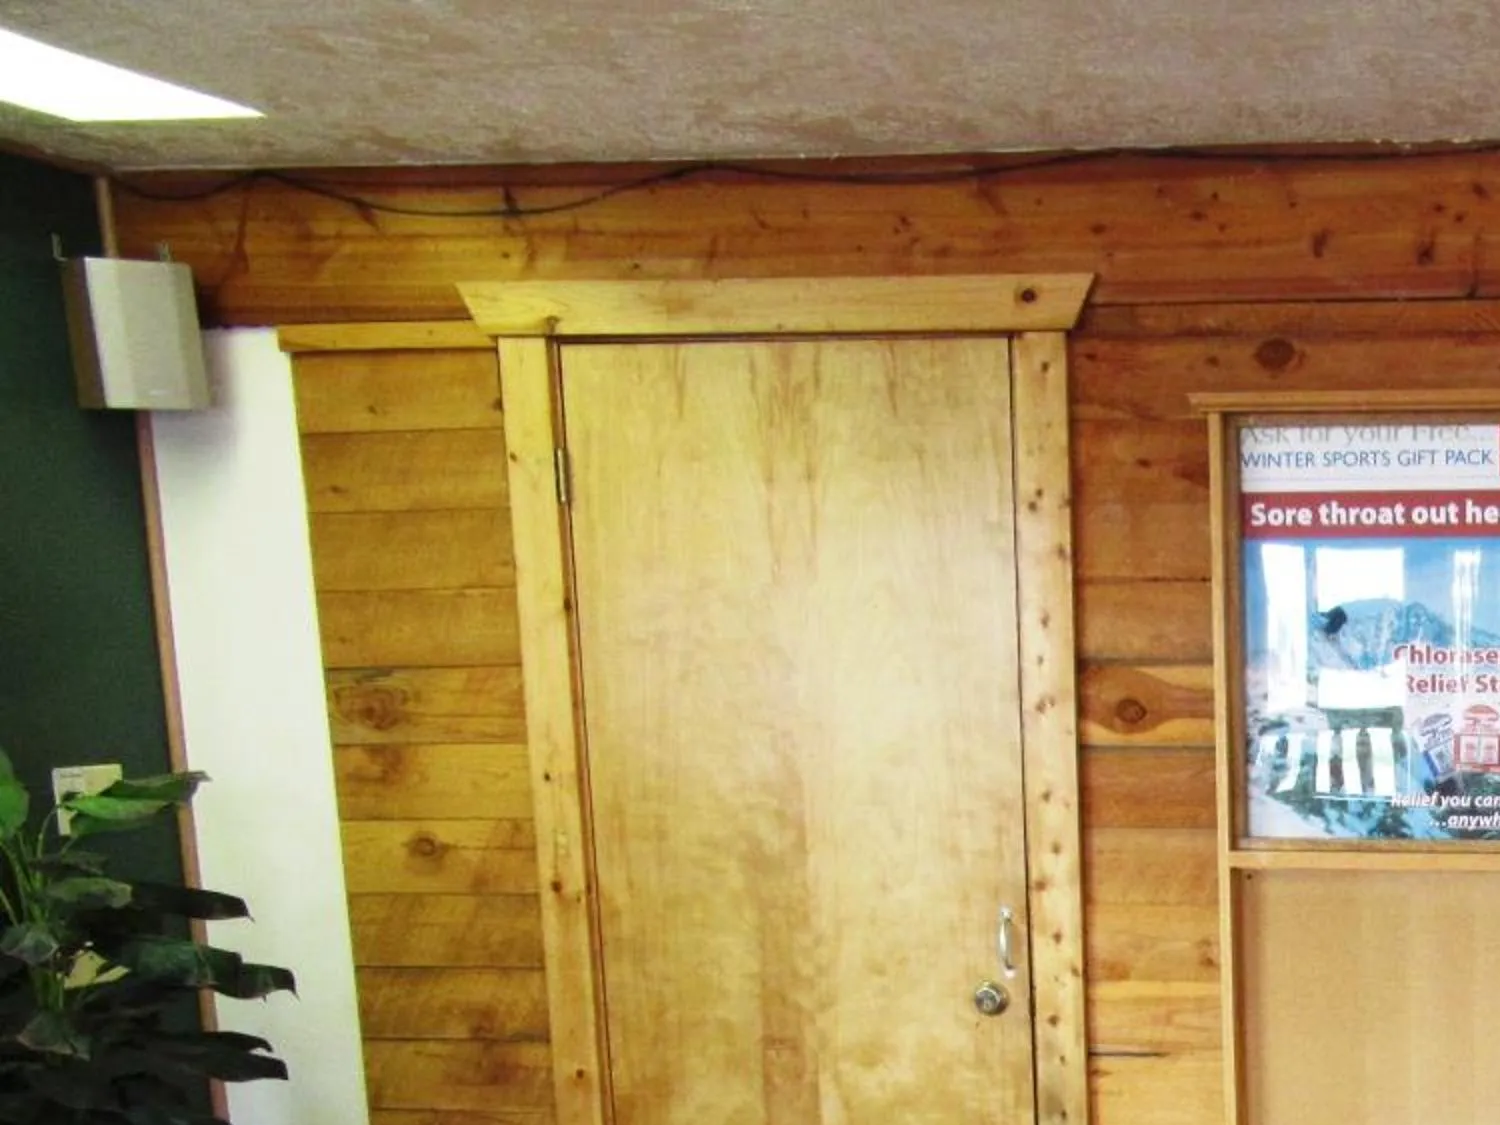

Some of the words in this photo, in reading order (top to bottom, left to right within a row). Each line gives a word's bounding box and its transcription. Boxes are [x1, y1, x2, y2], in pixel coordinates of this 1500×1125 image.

[1240, 451, 1316, 468] WINTER
[1322, 449, 1391, 467] SPORTS
[1397, 449, 1439, 467] GIFT
[1445, 448, 1494, 465] PACK
[1251, 503, 1312, 526] Sore
[1318, 501, 1405, 526] throat
[1411, 503, 1459, 525] out
[1440, 796, 1471, 810] you
